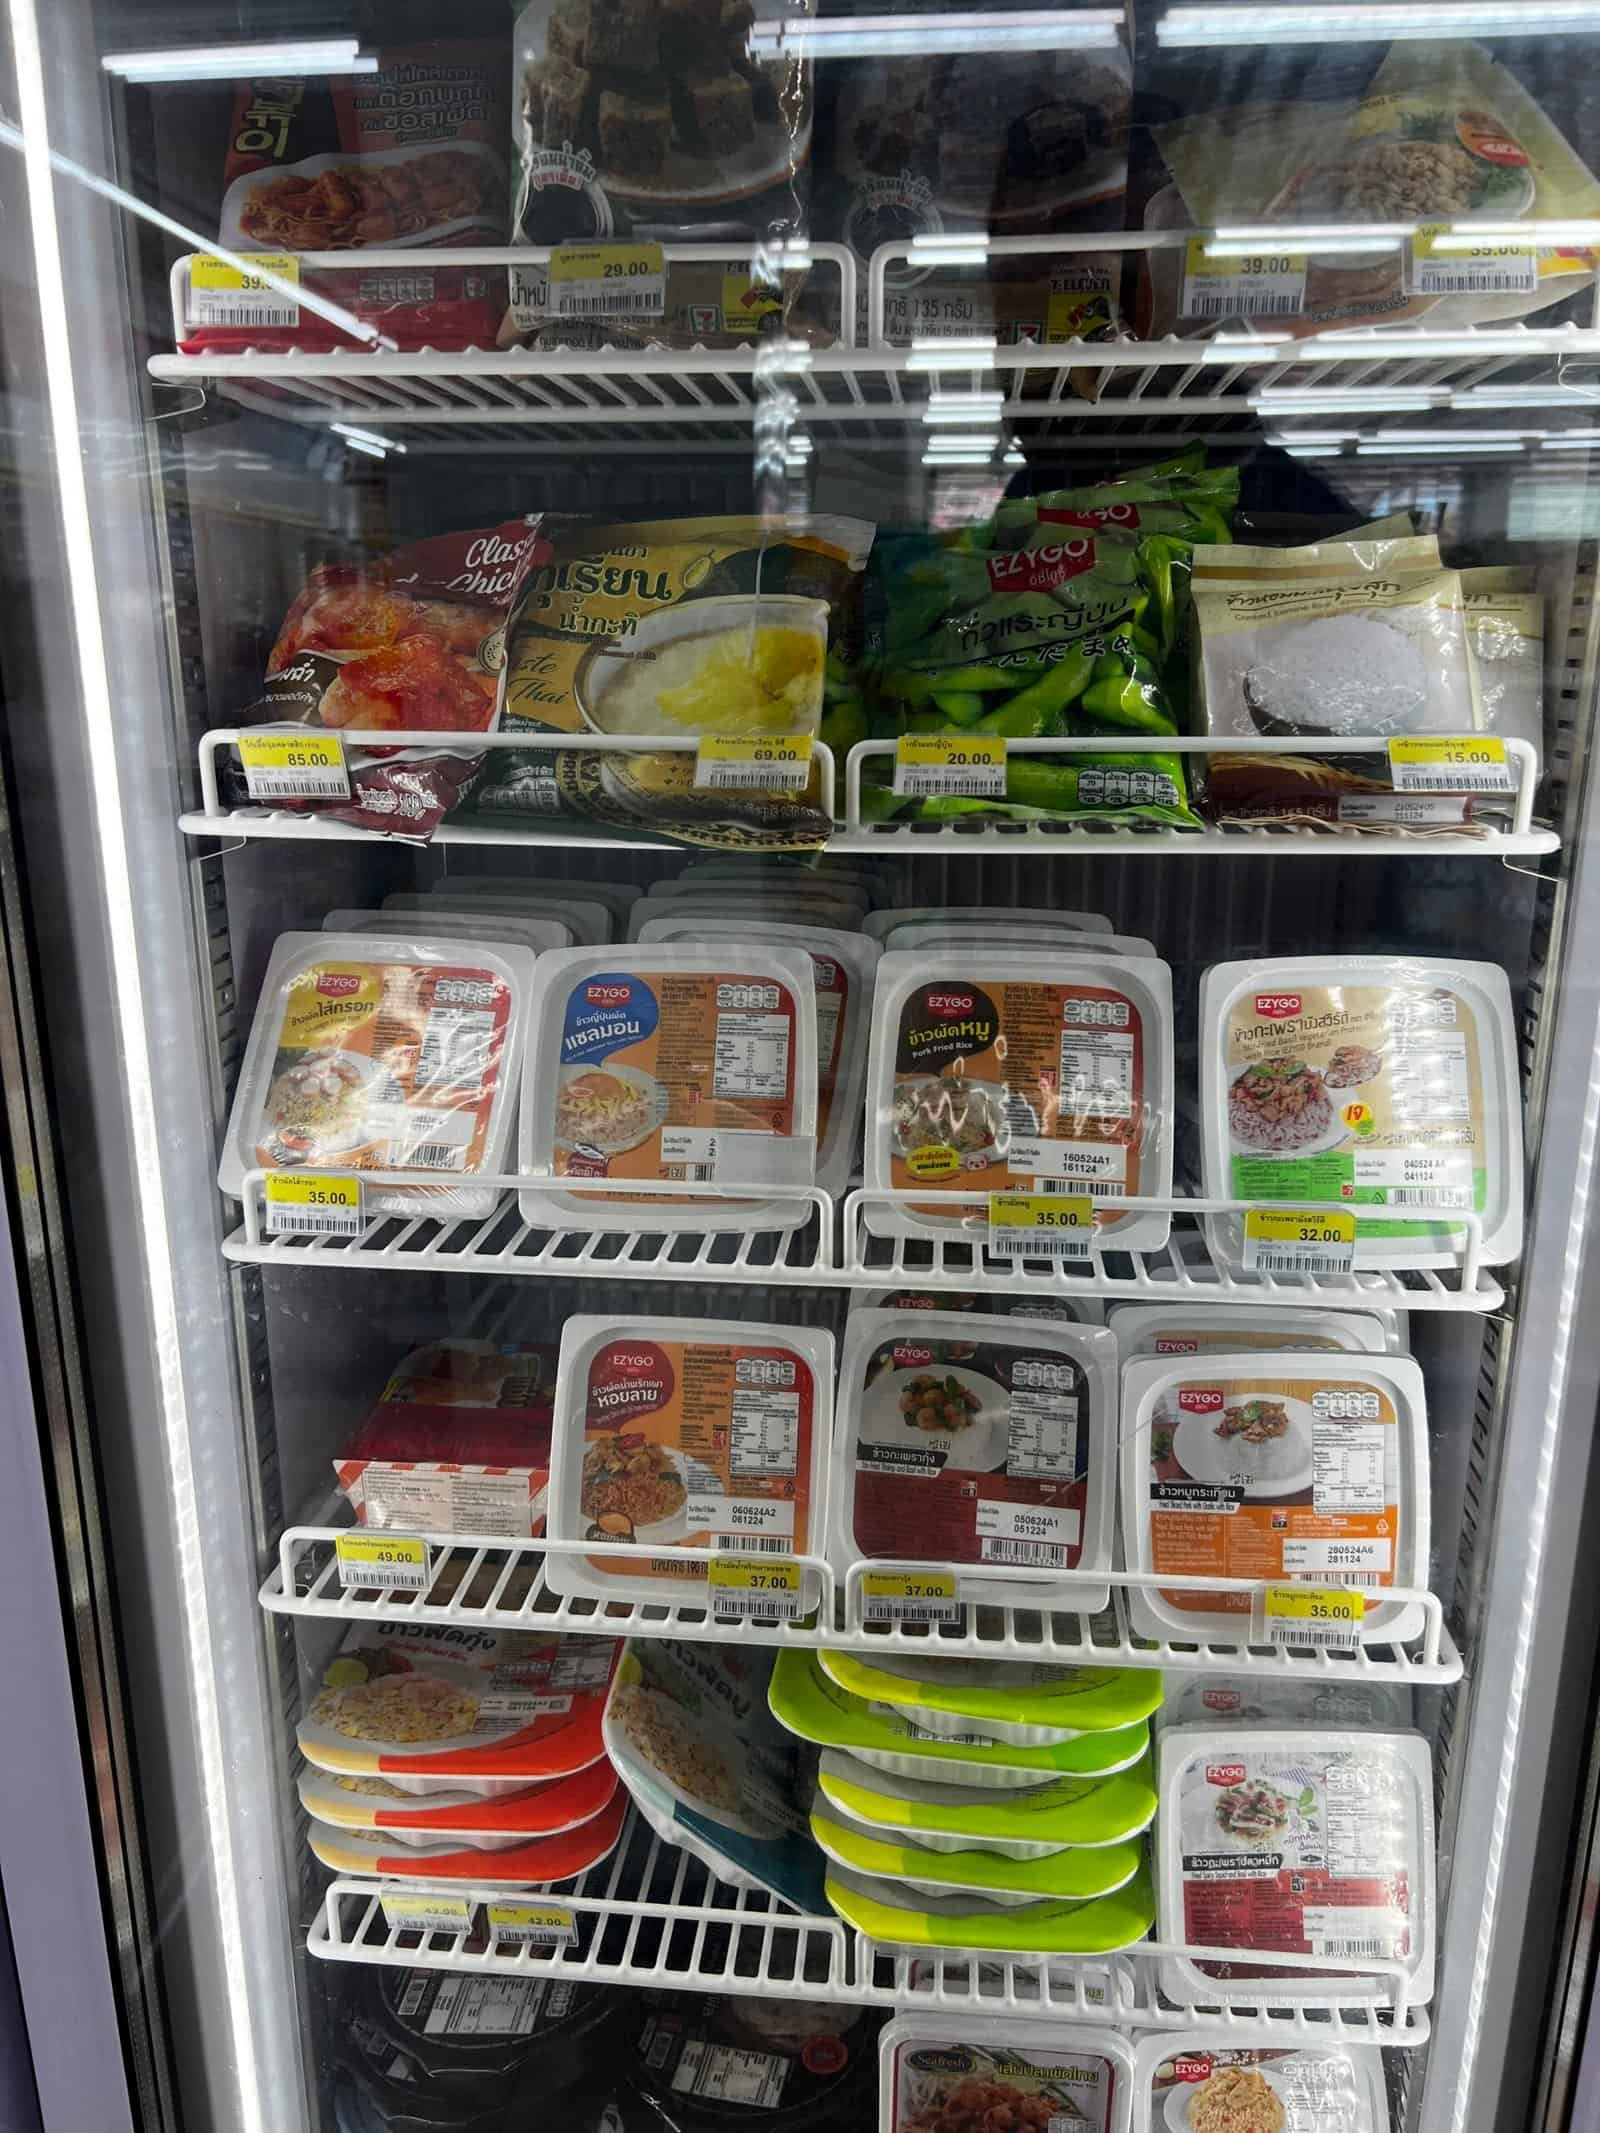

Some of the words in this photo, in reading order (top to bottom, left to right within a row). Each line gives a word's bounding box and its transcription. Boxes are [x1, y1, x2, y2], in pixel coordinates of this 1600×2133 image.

[603, 264, 648, 278] 29.00
[1240, 257, 1290, 273] 39.00
[992, 538, 1089, 577] EZYGO
[288, 753, 329, 766] 85.00
[754, 749, 797, 762] 69.00
[947, 752, 992, 766] 20.00
[1444, 751, 1491, 764] 15.00
[587, 986, 631, 999] EZYGO
[928, 997, 973, 1009] EZYGO
[1257, 999, 1300, 1009] EZYGO
[565, 1021, 641, 1051] แซลมอน
[908, 1021, 990, 1047] ข้าวผัดหมู
[955, 1041, 973, 1050] Rice
[308, 1192, 347, 1206] 35.00
[1036, 1212, 1078, 1226] 35.00
[1298, 1228, 1342, 1242] 32.00
[894, 1347, 930, 1359] EZYGO
[1157, 1341, 1196, 1352] EZYGO
[613, 1355, 655, 1367] EZYGO
[597, 1390, 657, 1409] หอยลาย
[1180, 1393, 1221, 1404] EZYGO
[1013, 1524, 1047, 1536] 051224
[376, 1551, 414, 1563] 49.00
[750, 1576, 788, 1590] 37.00
[904, 1585, 943, 1598] 37.00
[1310, 1604, 1351, 1619] 35.00
[1207, 1767, 1245, 1778] EZYGO
[527, 1916, 562, 1928] 42.00
[1174, 2064, 1209, 2074] EZYGO
